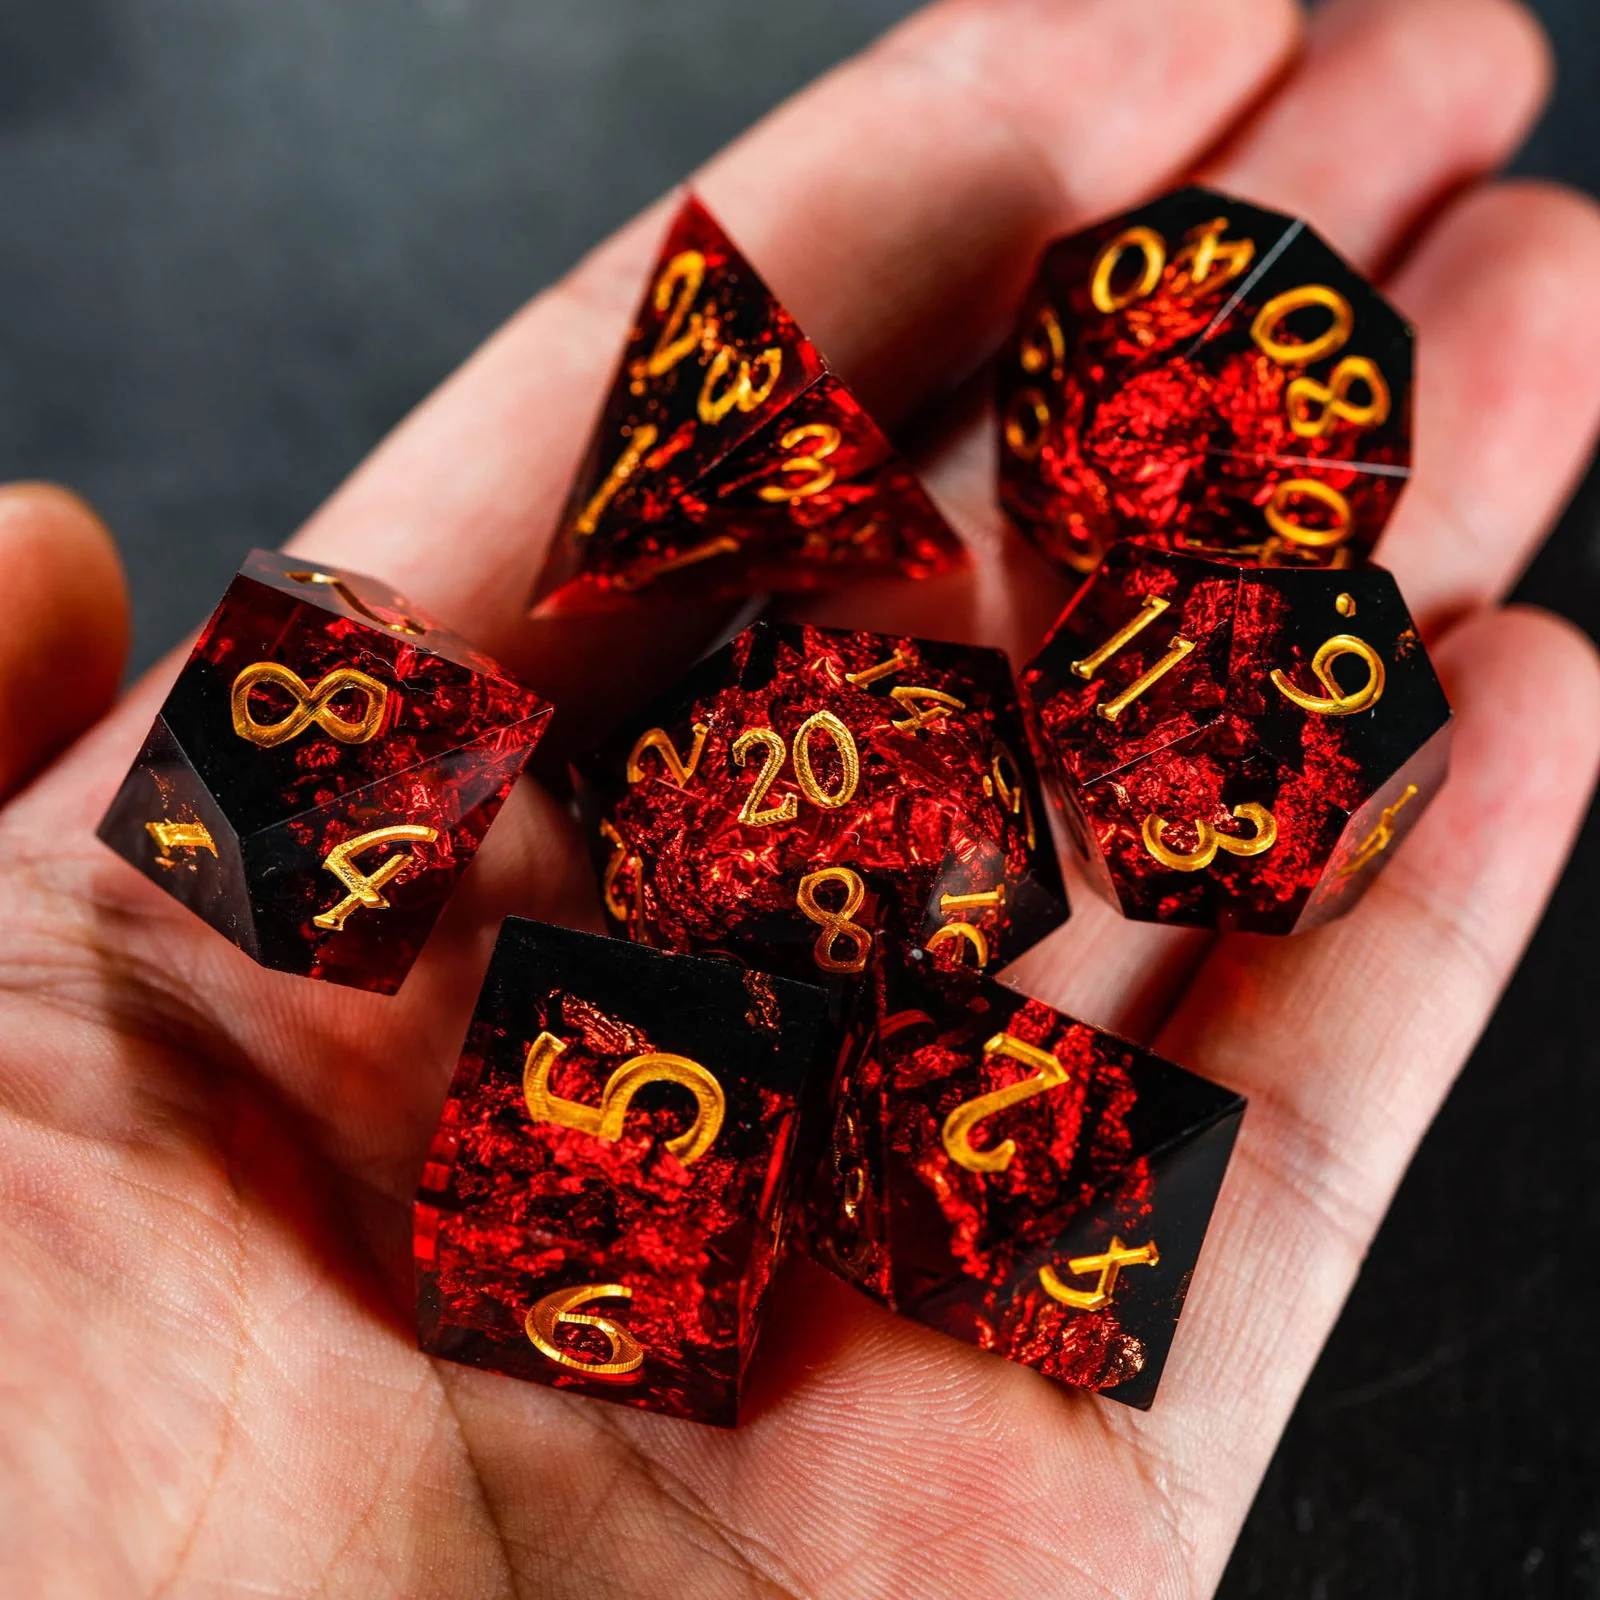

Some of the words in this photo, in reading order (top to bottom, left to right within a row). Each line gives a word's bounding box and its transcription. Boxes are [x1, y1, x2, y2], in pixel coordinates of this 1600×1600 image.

[656, 251, 705, 376] 2
[1251, 285, 1390, 437] 80
[759, 424, 840, 500] 3
[231, 662, 388, 748] 8
[1070, 595, 1198, 721] 11
[732, 710, 859, 827] 20
[313, 825, 439, 931] 4
[1142, 802, 1278, 871] 3
[797, 867, 872, 973] 8
[523, 1031, 726, 1168] 5
[942, 1032, 1071, 1172] 2
[1039, 1235, 1160, 1312] 4
[525, 1284, 645, 1374] 6
